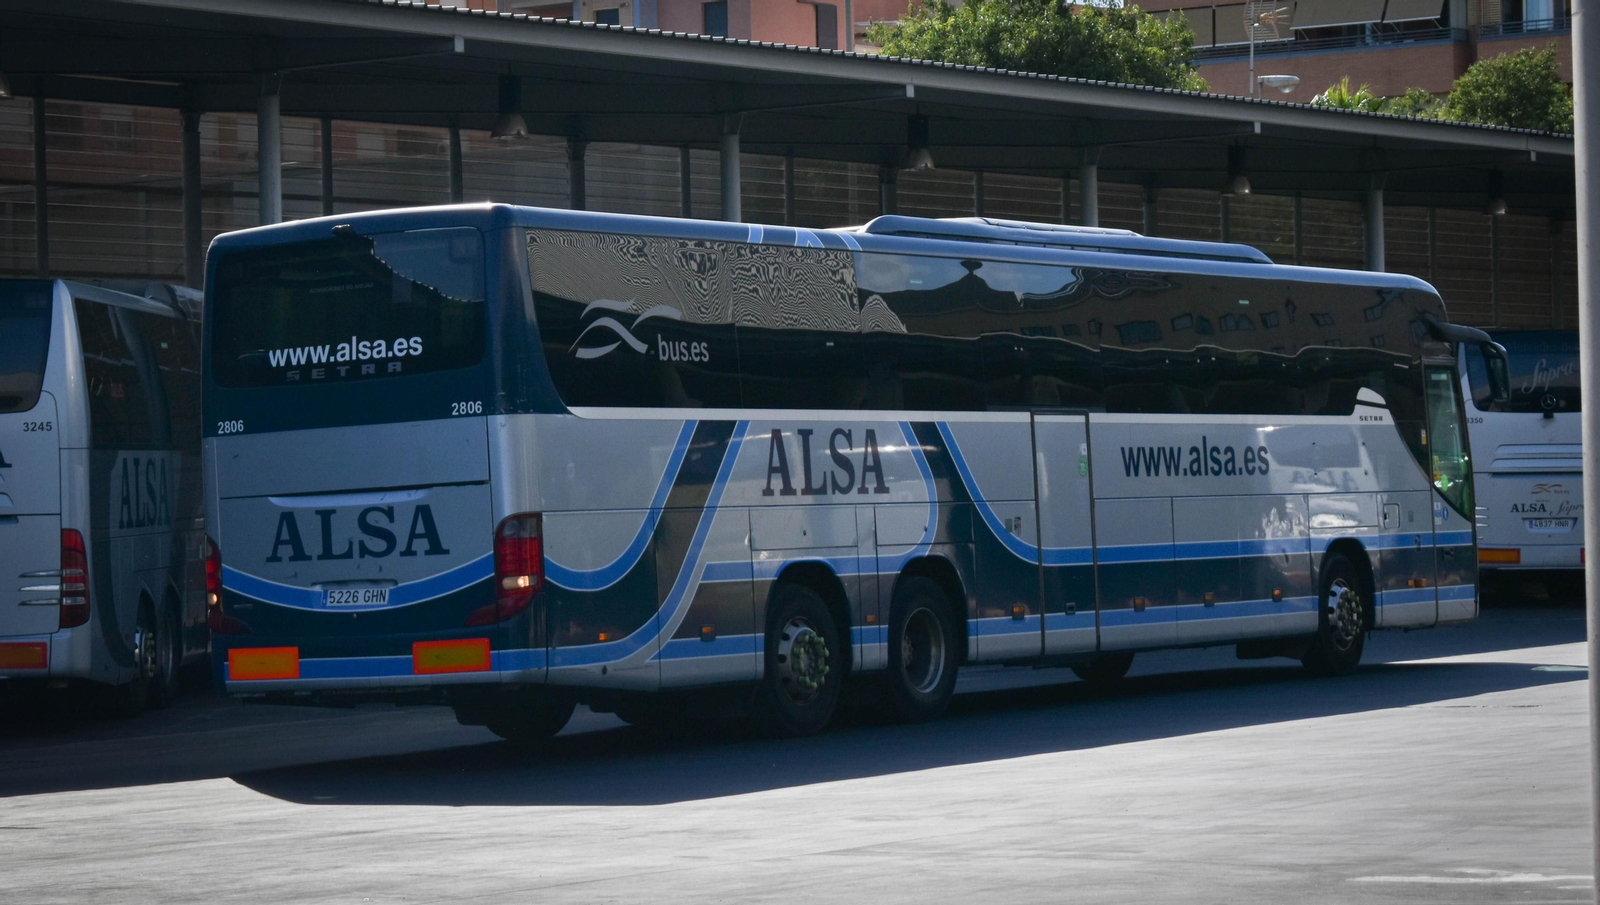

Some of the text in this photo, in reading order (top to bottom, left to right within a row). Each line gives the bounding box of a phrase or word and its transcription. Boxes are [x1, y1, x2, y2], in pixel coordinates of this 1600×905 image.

[269, 336, 423, 367] www.alsa.es
[657, 334, 709, 362] bus.es
[286, 361, 402, 382] SETRA
[1521, 358, 1574, 394] Supra
[452, 401, 483, 415] 2806
[23, 422, 52, 432] 3245
[218, 420, 244, 434] 2806
[762, 428, 890, 496] ALSA
[1121, 435, 1270, 477] www.alsa.es
[119, 457, 171, 529] ALSA
[1510, 503, 1547, 513] ALSA
[265, 503, 450, 563] ALSA
[1534, 520, 1569, 528] 4837 HNR
[329, 589, 387, 604] 5226 GHN
